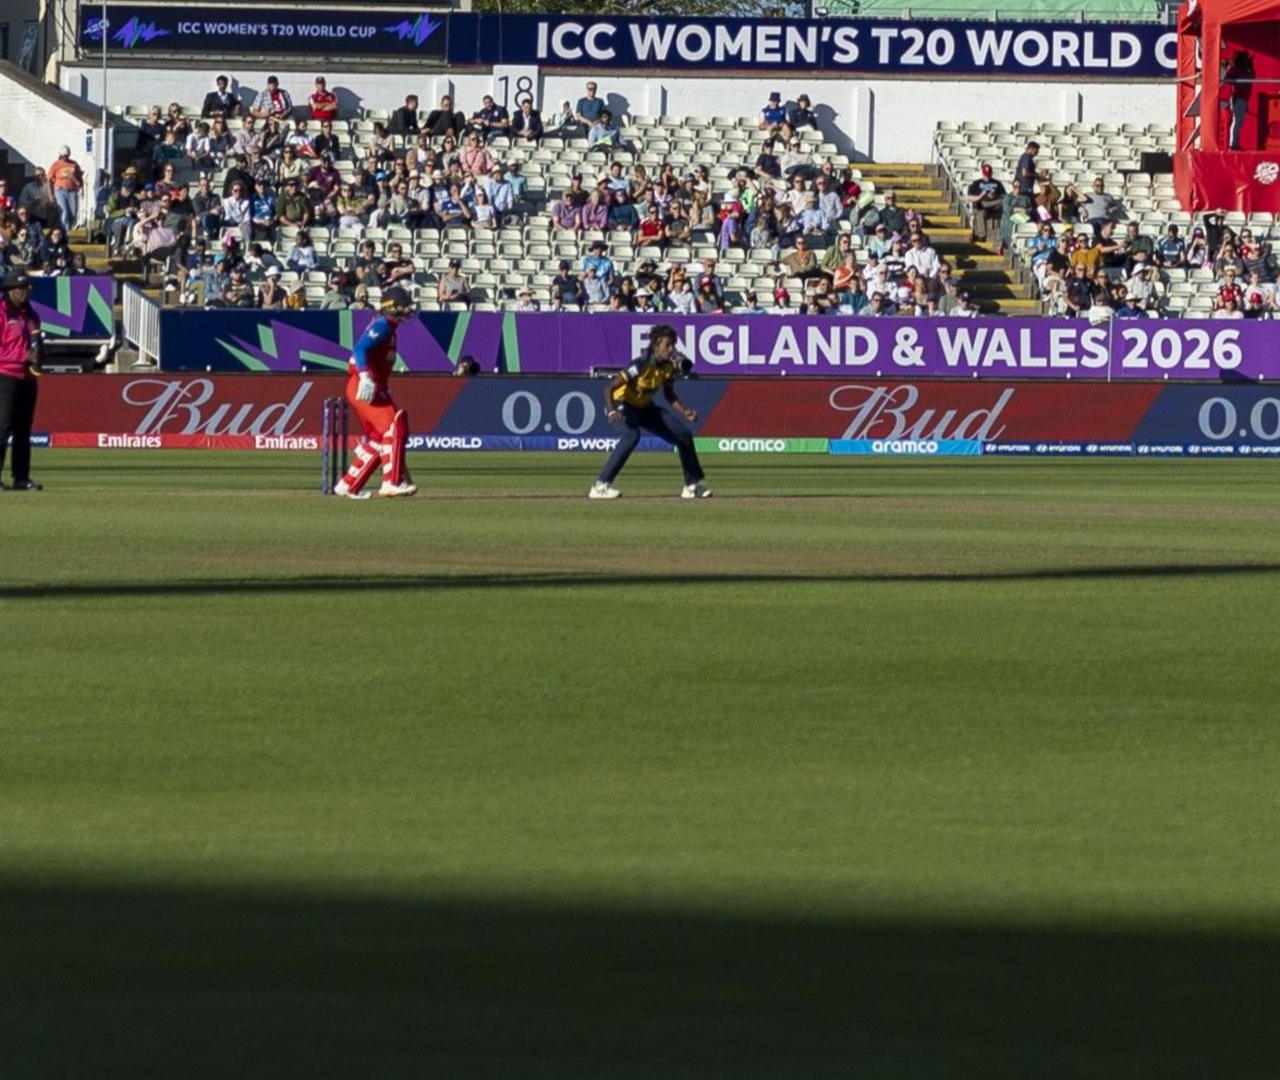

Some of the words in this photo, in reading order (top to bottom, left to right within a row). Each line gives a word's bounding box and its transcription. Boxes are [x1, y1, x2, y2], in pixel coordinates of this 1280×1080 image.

[178, 22, 200, 34] ICC
[204, 22, 268, 35] WOMEN'S
[271, 24, 294, 37] T20
[297, 25, 345, 37] WORLD
[349, 25, 376, 38] CUP
[536, 21, 617, 60] ICC
[629, 22, 860, 64] WOMEN'S
[870, 27, 955, 67] T20
[965, 29, 1142, 69] WORLD
[498, 75, 534, 110] 18
[892, 326, 926, 366] &
[936, 326, 1109, 368] WALES
[1121, 328, 1243, 369] 2026
[122, 378, 314, 436] Bud
[502, 390, 596, 435] 0.0
[829, 384, 1015, 441] Bud
[97, 433, 162, 449] Emirates
[255, 434, 318, 450] Emirates
[426, 437, 482, 450] WORLD
[558, 437, 579, 450] DP
[580, 437, 620, 450] WOR
[718, 438, 785, 452] aramco
[871, 440, 938, 454] aramco
